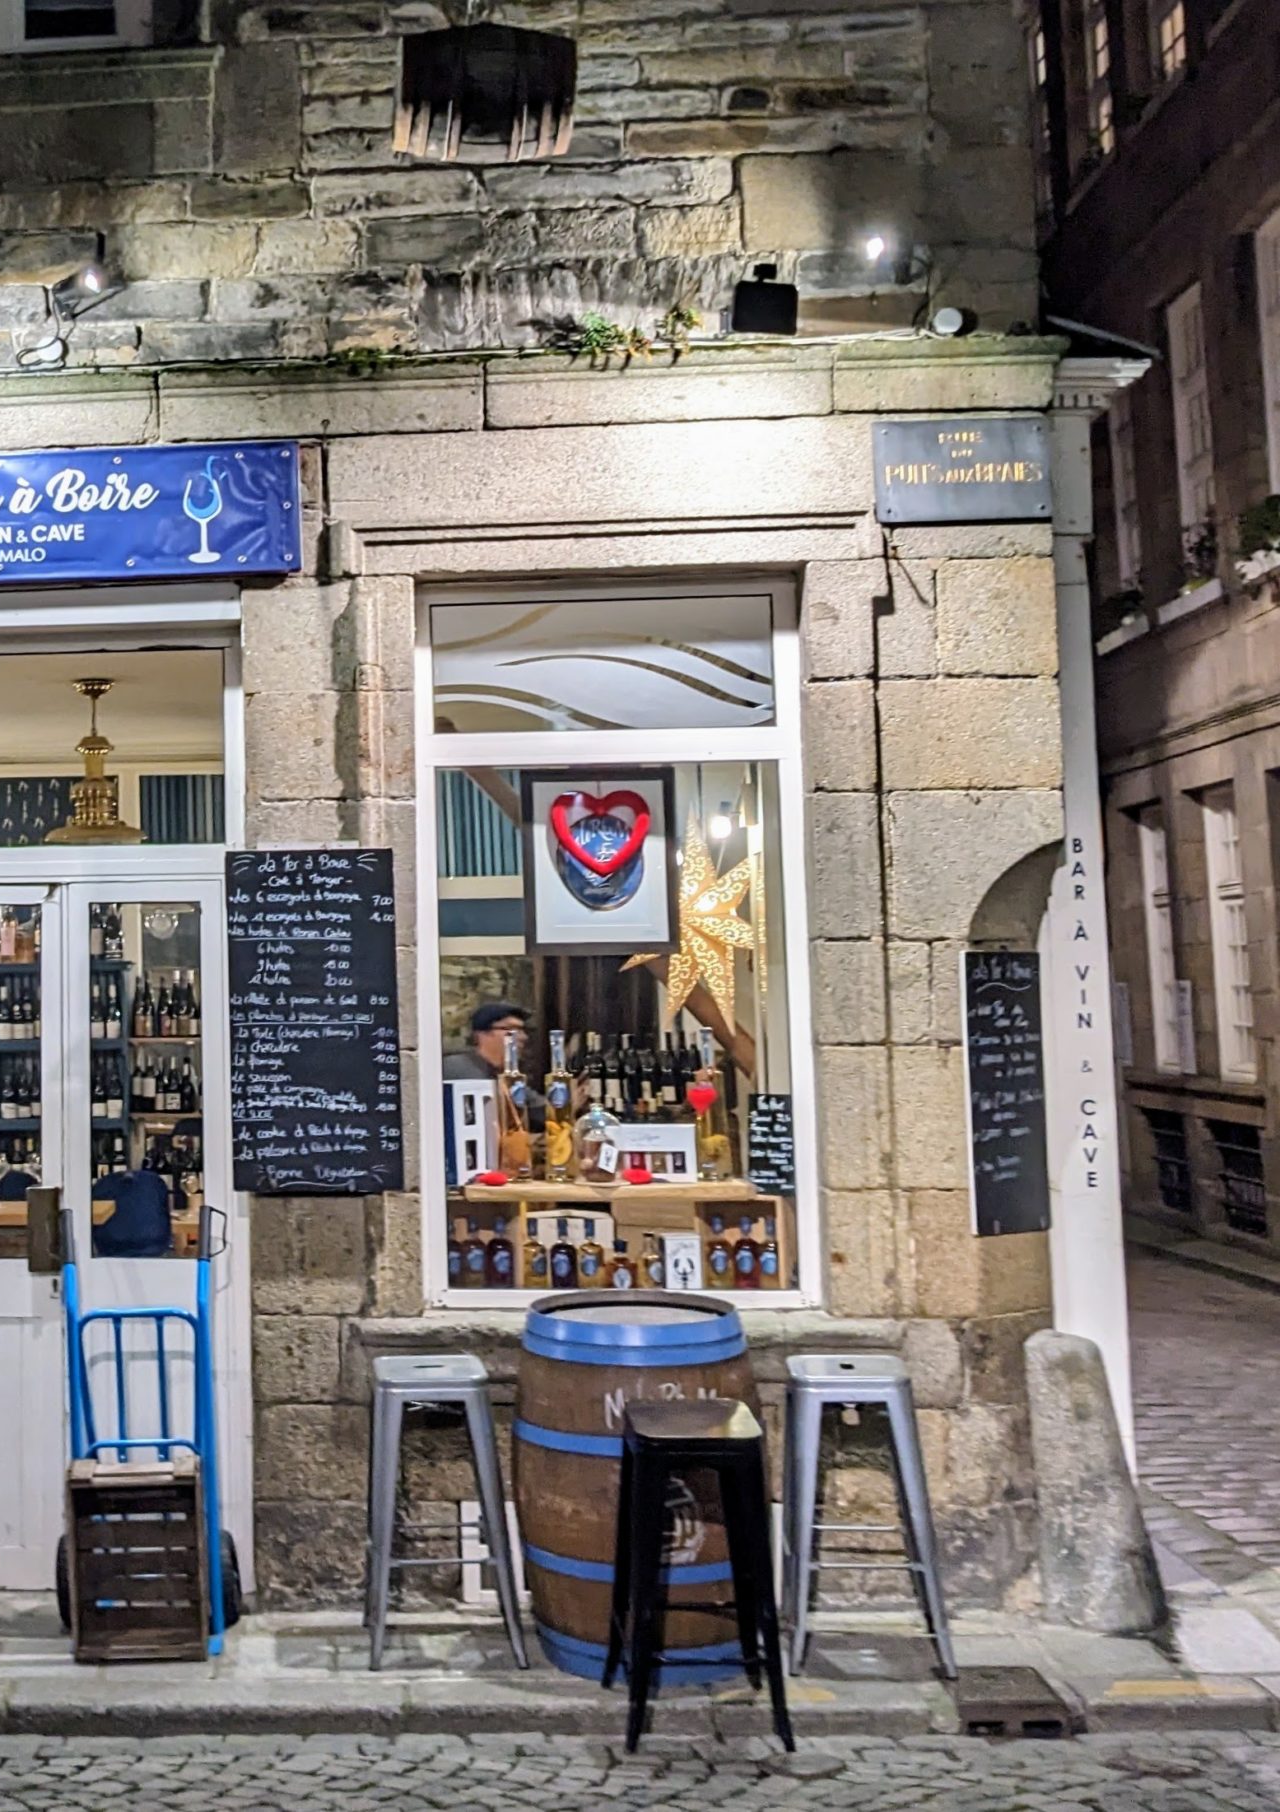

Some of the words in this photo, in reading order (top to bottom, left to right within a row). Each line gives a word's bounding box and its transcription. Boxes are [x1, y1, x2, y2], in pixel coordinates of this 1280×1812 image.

[9, 473, 43, 516] à
[45, 467, 161, 514] Boire
[16, 529, 28, 544] &
[31, 522, 86, 543] CAVE
[1071, 838, 1086, 900] BAR
[1074, 921, 1089, 942] À
[1076, 965, 1093, 1029] VIN
[1081, 1099, 1099, 1188] CAVE
